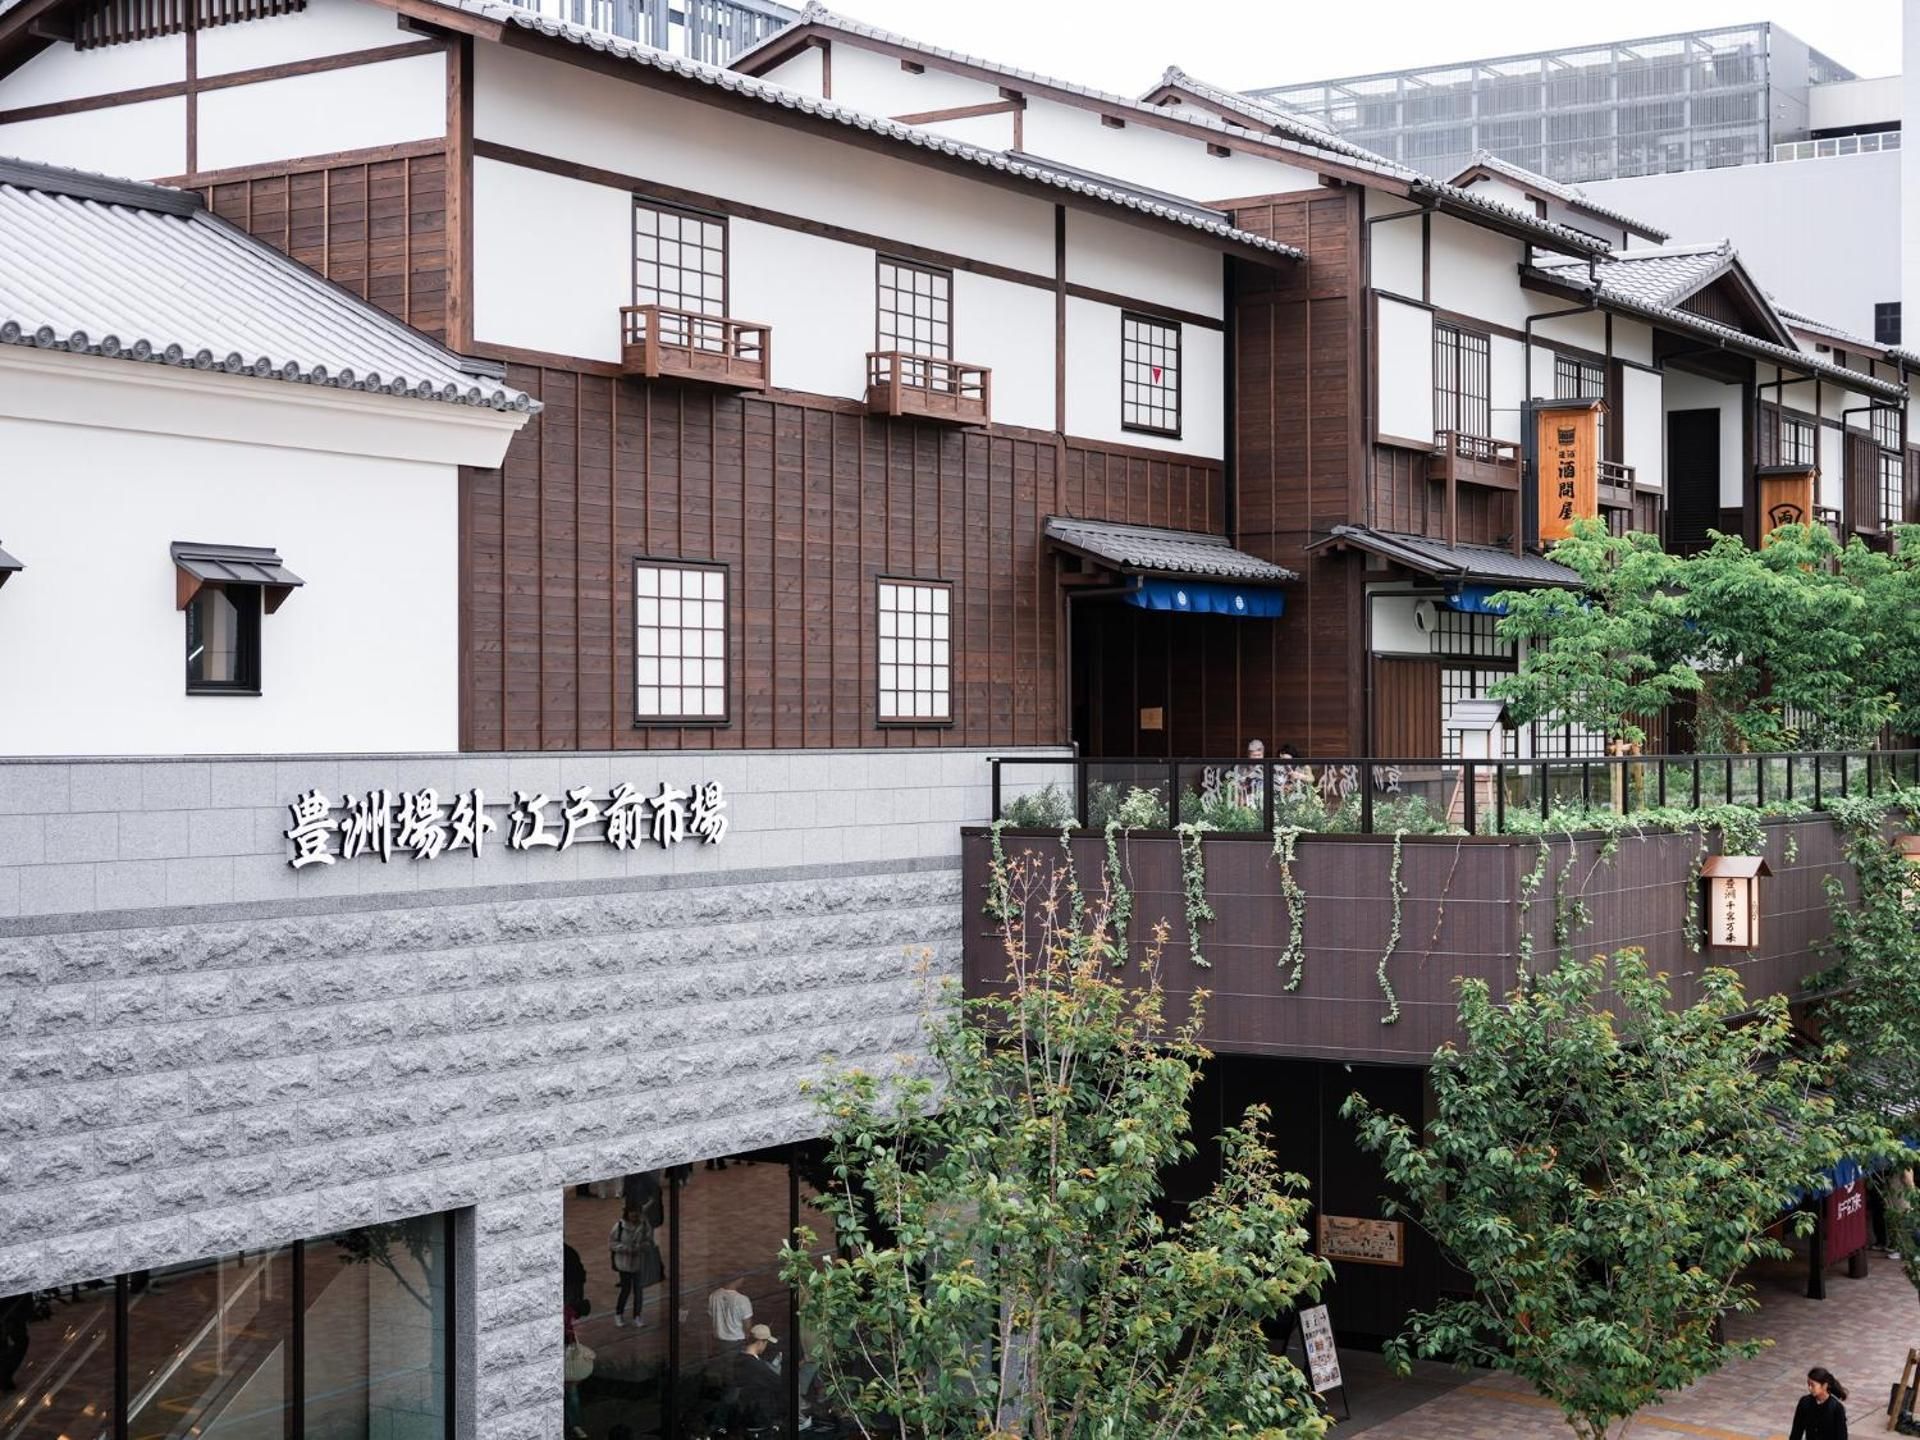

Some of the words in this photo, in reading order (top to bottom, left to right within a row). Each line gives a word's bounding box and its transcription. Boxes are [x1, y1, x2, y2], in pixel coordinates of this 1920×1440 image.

[1558, 461, 1575, 520] 酒問屋
[286, 788, 495, 868] 豊洲場外
[508, 780, 729, 851] 江戸前市場
